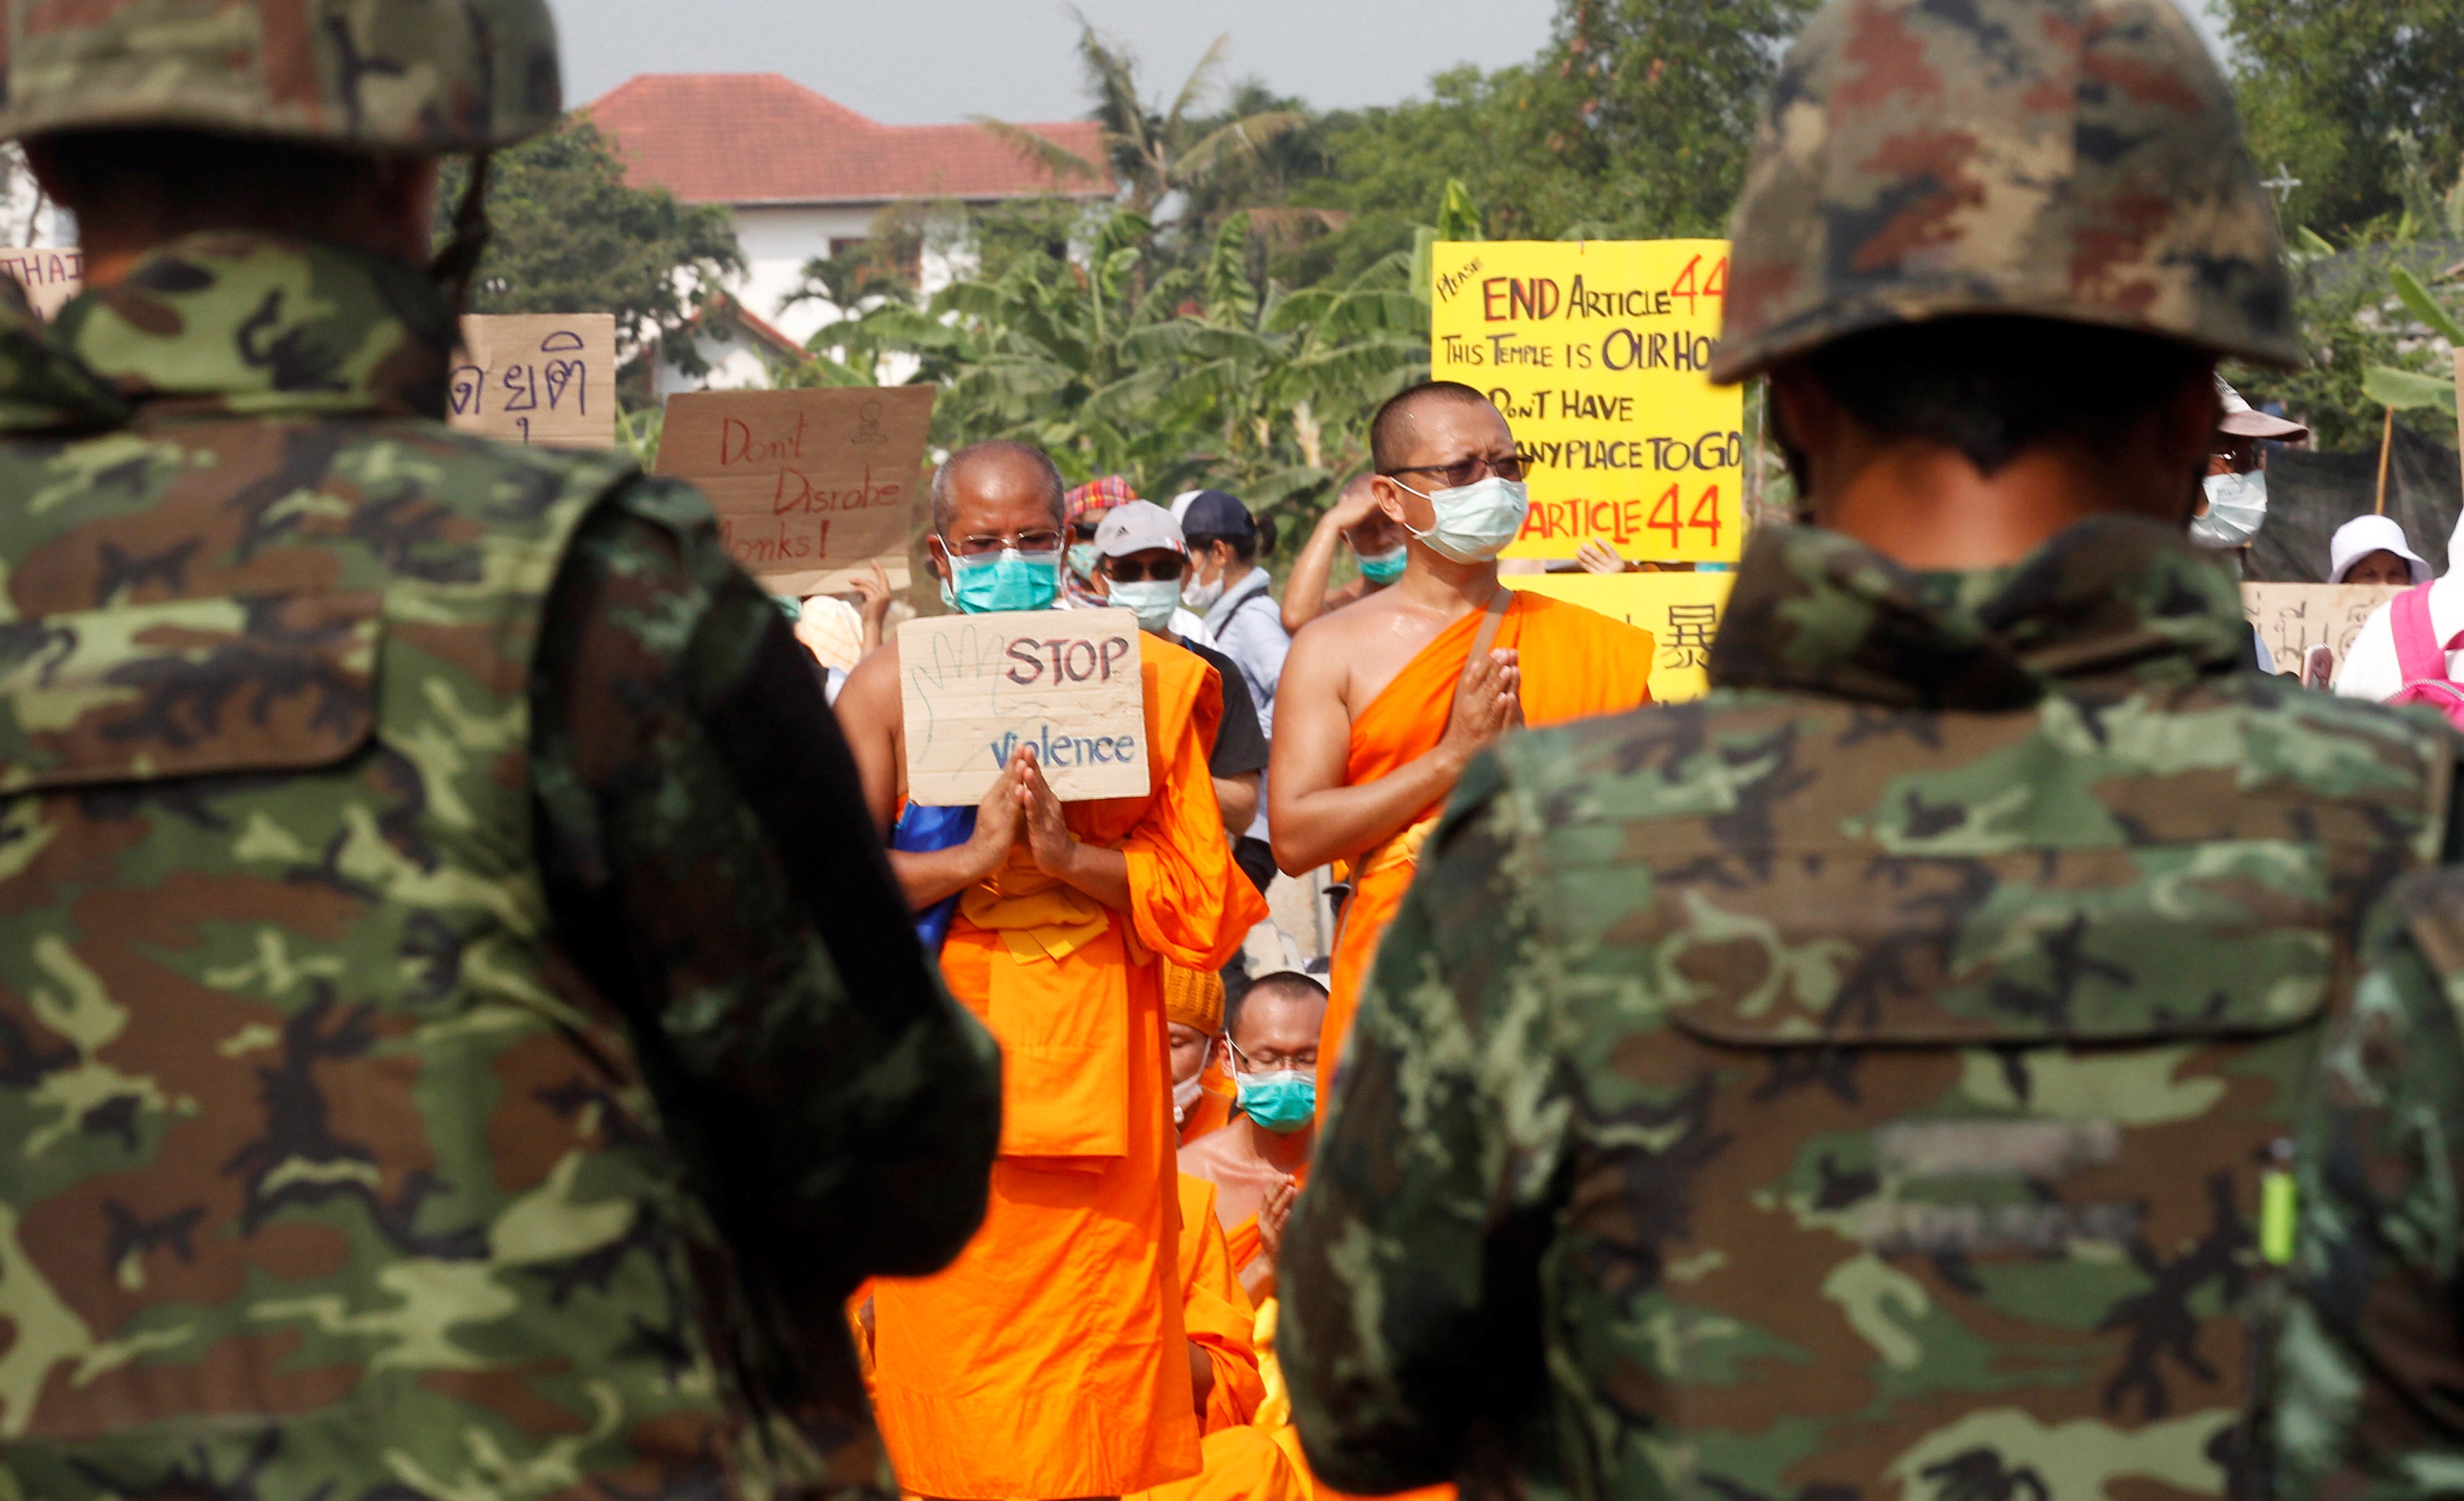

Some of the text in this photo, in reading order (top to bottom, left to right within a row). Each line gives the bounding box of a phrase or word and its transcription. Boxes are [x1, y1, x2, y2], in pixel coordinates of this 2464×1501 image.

[1482, 277, 1560, 322] END
[1671, 253, 1729, 318] 44
[1566, 343, 1592, 369] IS
[1602, 328, 1669, 371] OUR
[1673, 330, 1719, 372] HO
[1561, 389, 1635, 422] HAVE
[721, 412, 810, 465] Don't
[1565, 440, 1643, 470] PLACE
[774, 464, 900, 516] Disrobe
[1518, 483, 1722, 550] ARTICLE 44
[1006, 637, 1129, 686] STOP
